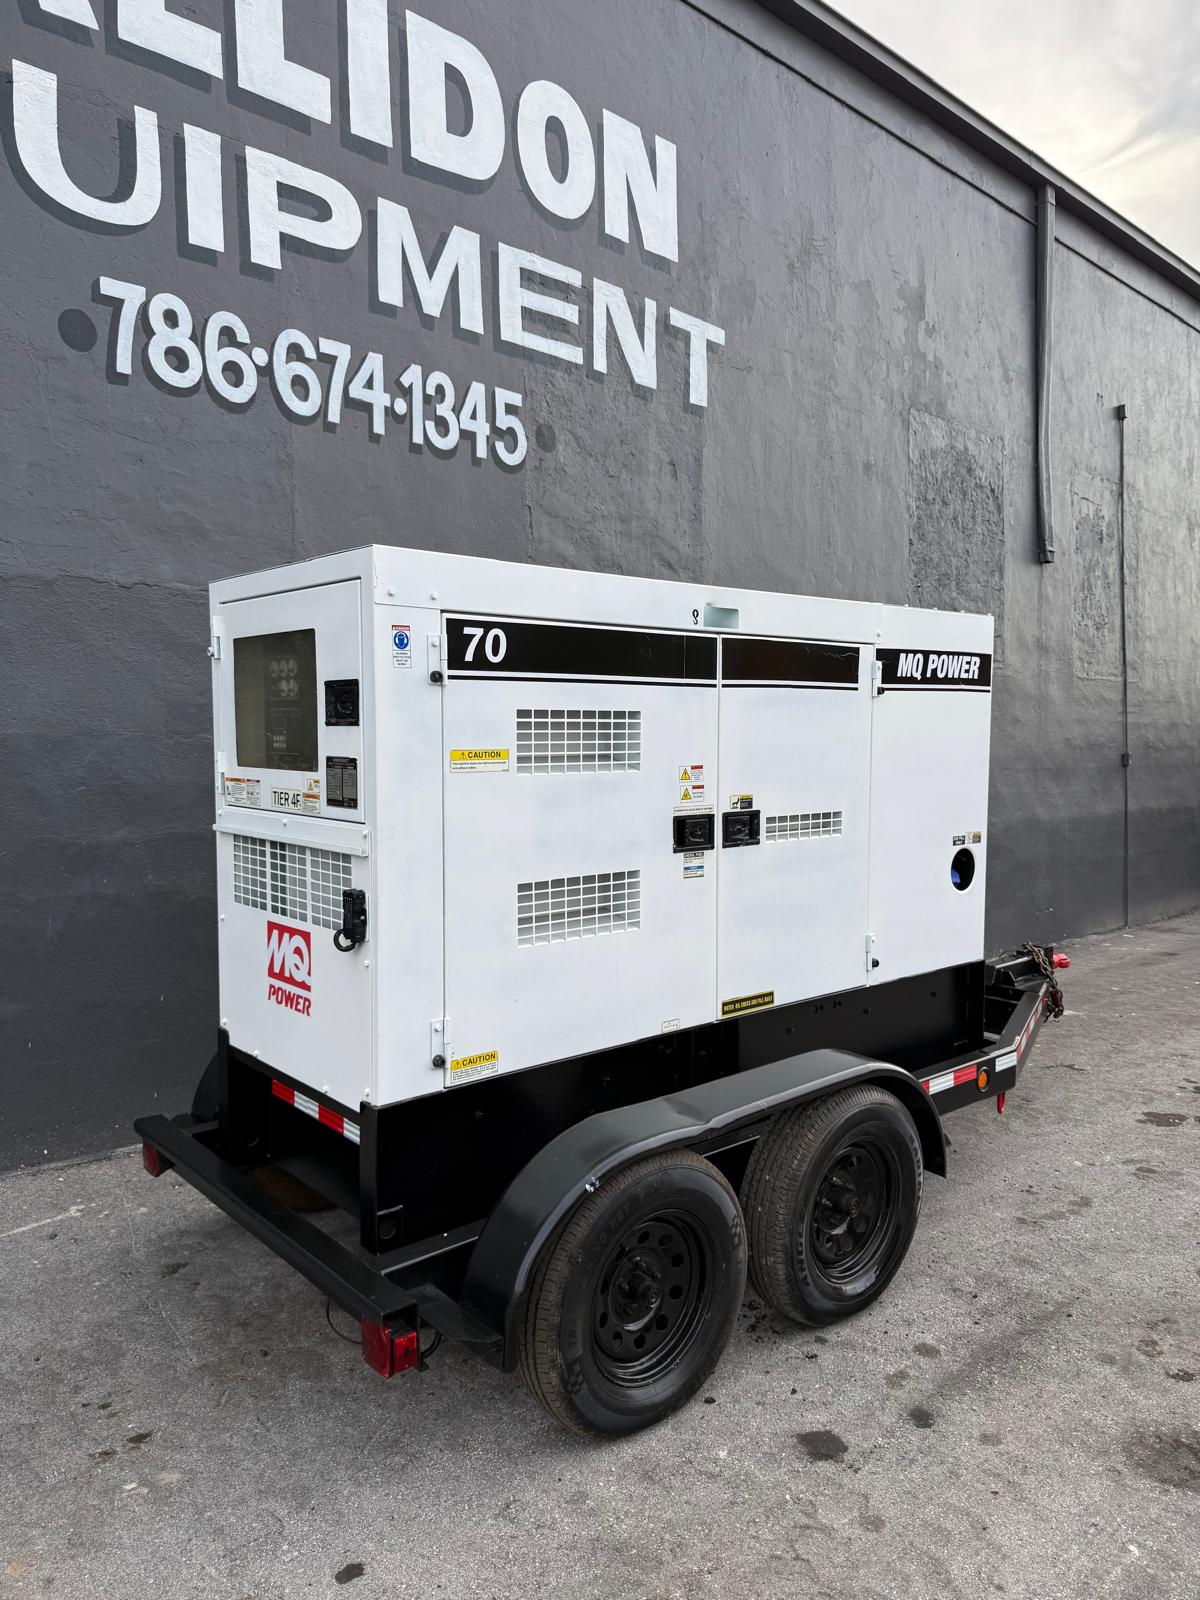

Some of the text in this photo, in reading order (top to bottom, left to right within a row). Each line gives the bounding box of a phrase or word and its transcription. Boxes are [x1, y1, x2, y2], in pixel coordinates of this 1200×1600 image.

[39, 0, 679, 262] LIDON
[462, 626, 508, 663] 70
[897, 653, 981, 681] MQ POWER
[467, 751, 501, 759] CAUTION
[272, 790, 290, 807] TIER
[267, 929, 311, 987] MQ
[268, 983, 312, 1017] POWER
[462, 1052, 496, 1067] CAUTION
